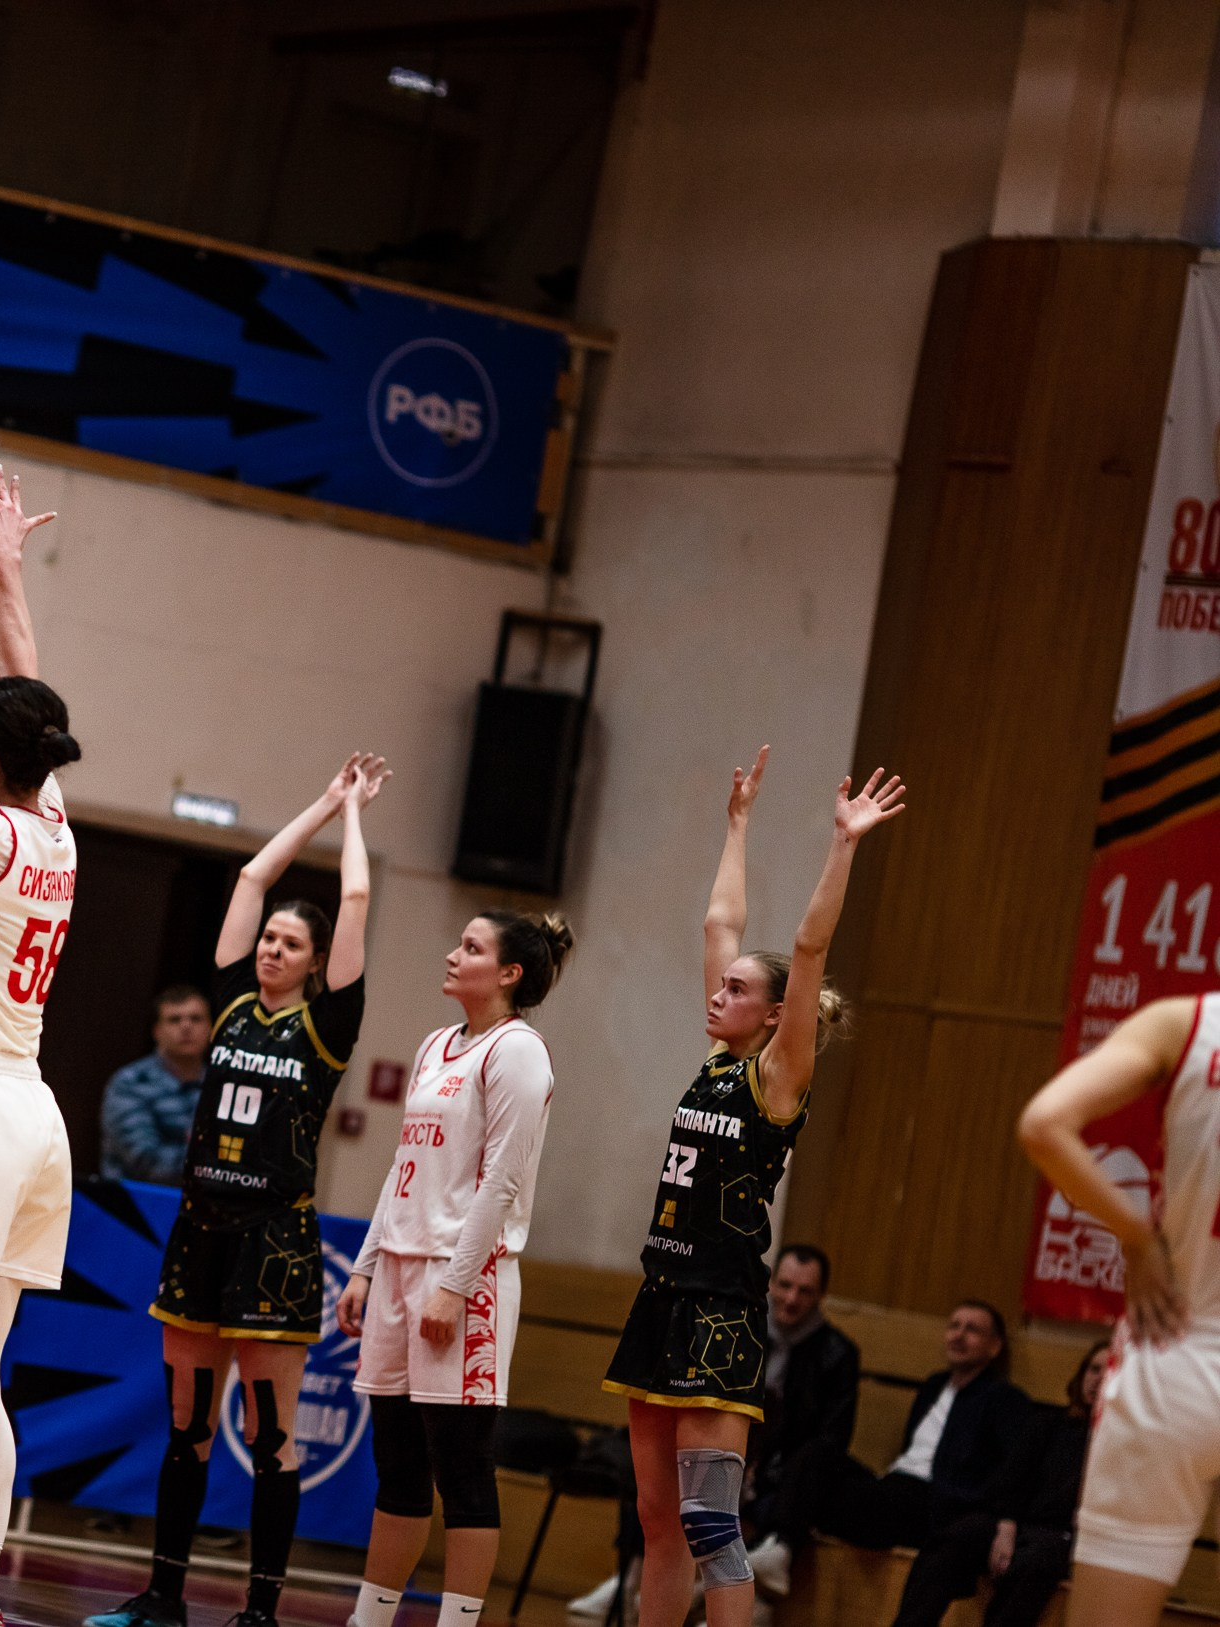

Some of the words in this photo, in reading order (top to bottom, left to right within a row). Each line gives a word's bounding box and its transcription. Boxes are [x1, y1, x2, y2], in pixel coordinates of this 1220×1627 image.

[386, 383, 482, 440] РФБ
[1168, 497, 1220, 577] 80
[1143, 878, 1220, 974] 41
[7, 916, 70, 1005] 58
[217, 1082, 262, 1125] 10
[394, 1160, 416, 1199] 12
[661, 1142, 698, 1188] 32
